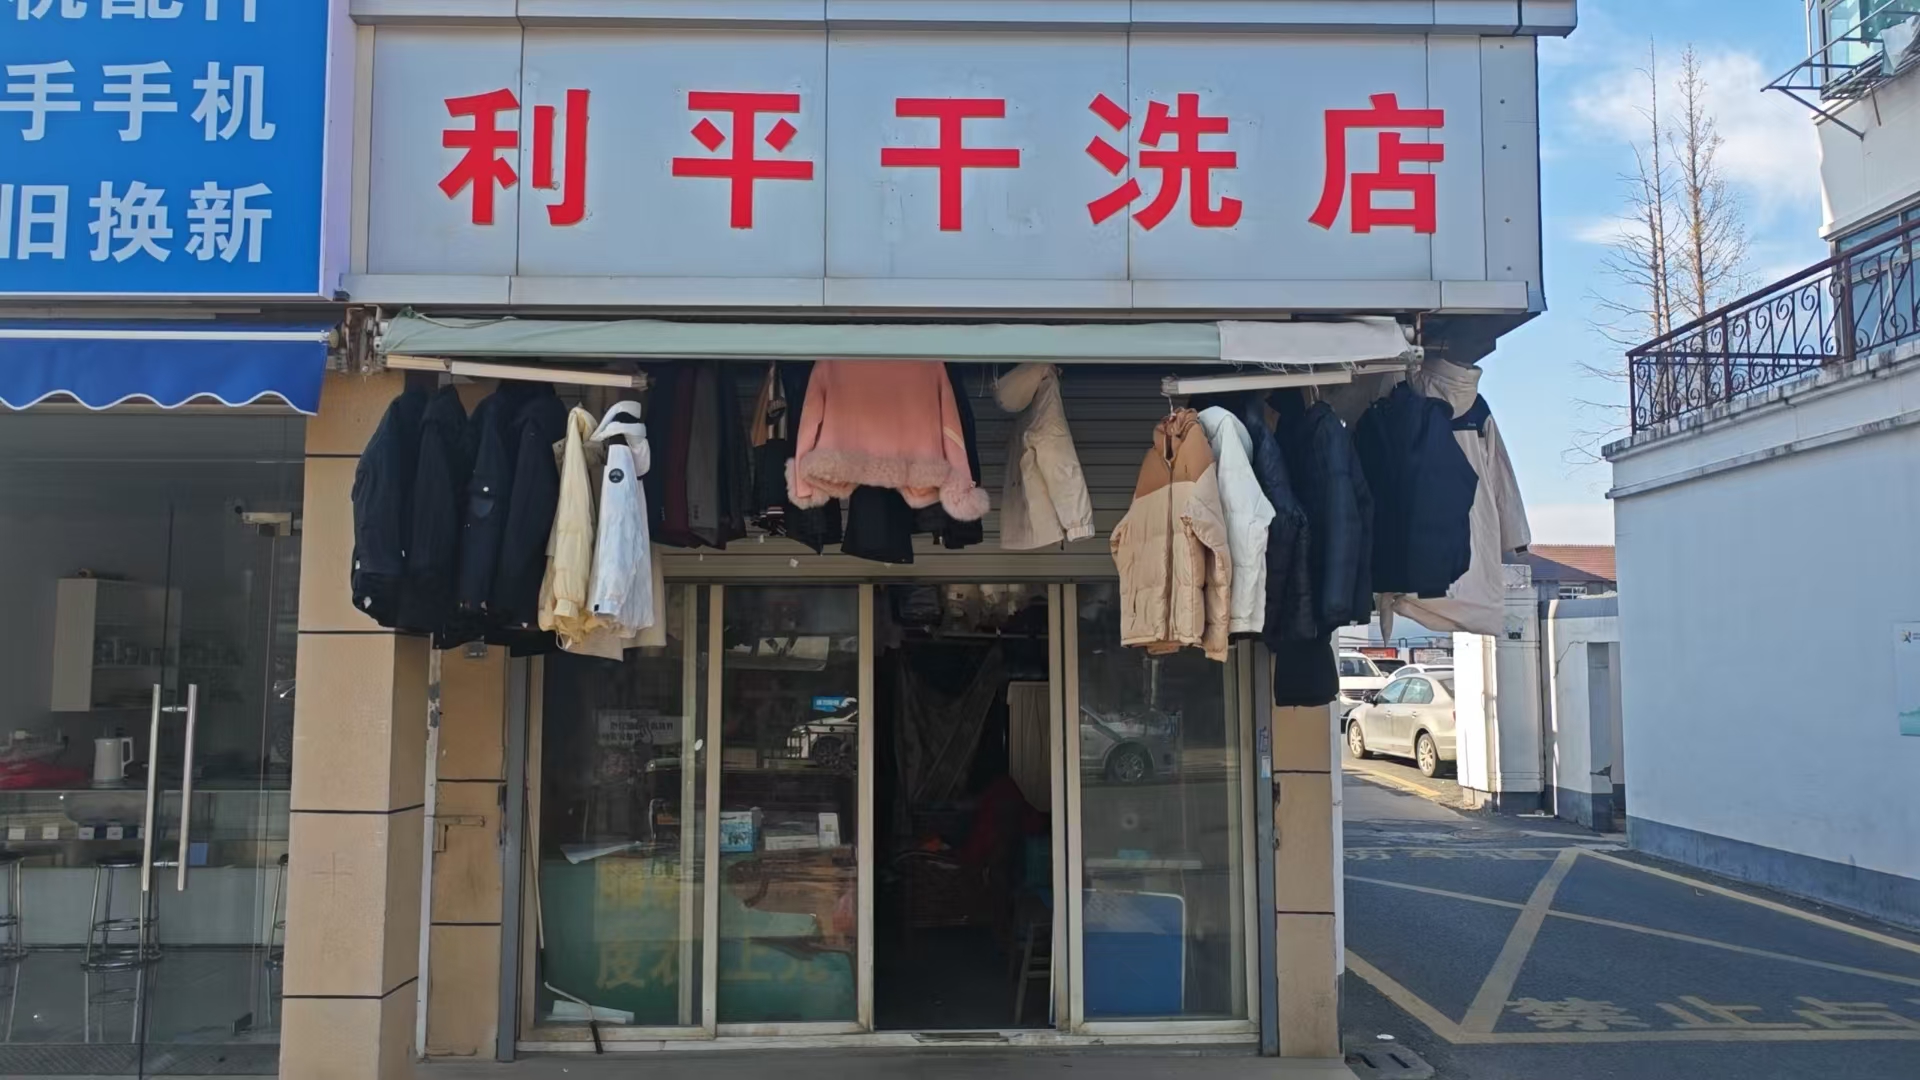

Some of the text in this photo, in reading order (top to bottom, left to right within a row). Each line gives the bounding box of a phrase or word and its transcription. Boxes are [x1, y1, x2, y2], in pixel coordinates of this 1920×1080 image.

[0, 60, 276, 142] 手手机
[439, 88, 1446, 234] 利平干洗店
[0, 181, 272, 263] 旧换新
[1504, 994, 1920, 1031] 禁止占
